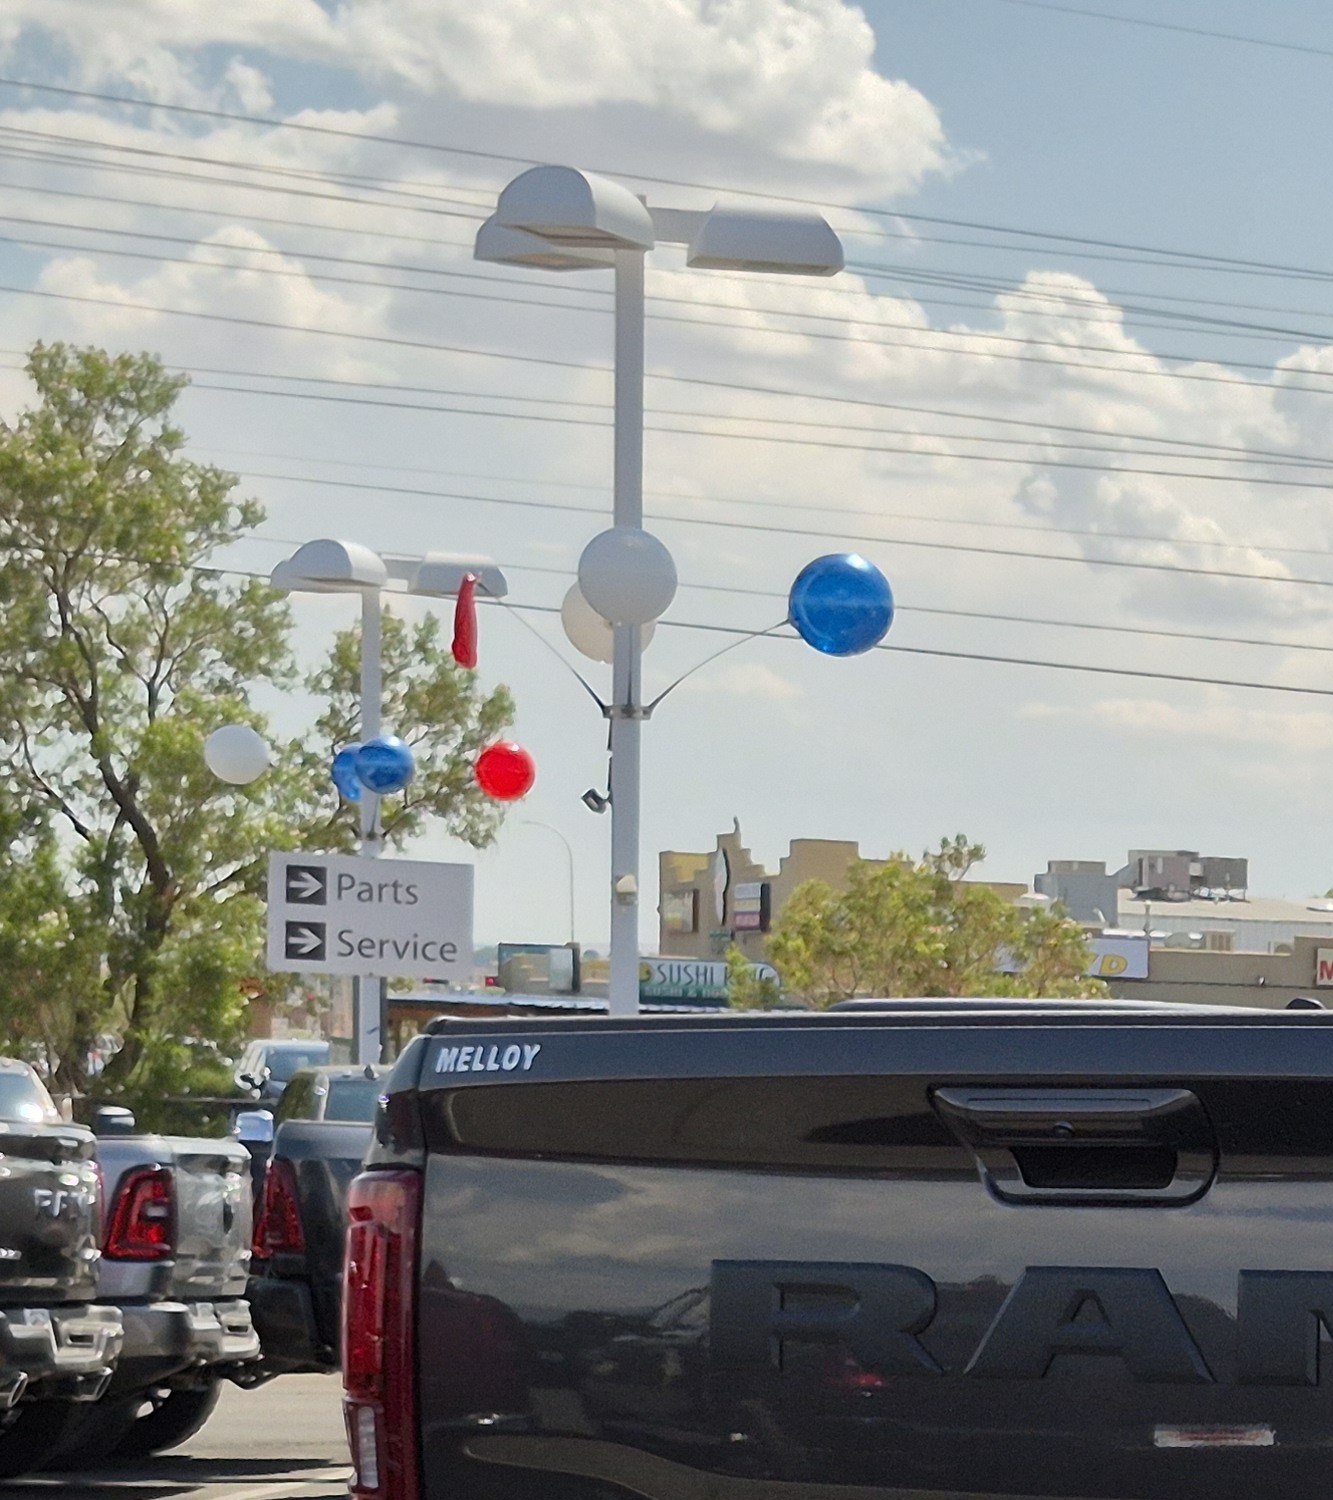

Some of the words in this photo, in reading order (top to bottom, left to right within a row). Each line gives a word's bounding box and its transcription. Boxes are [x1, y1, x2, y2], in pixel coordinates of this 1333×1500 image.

[336, 873, 419, 906] Parts
[336, 929, 458, 963] Service
[656, 964, 715, 986] SUSHI
[434, 1043, 542, 1073] MELLOY
